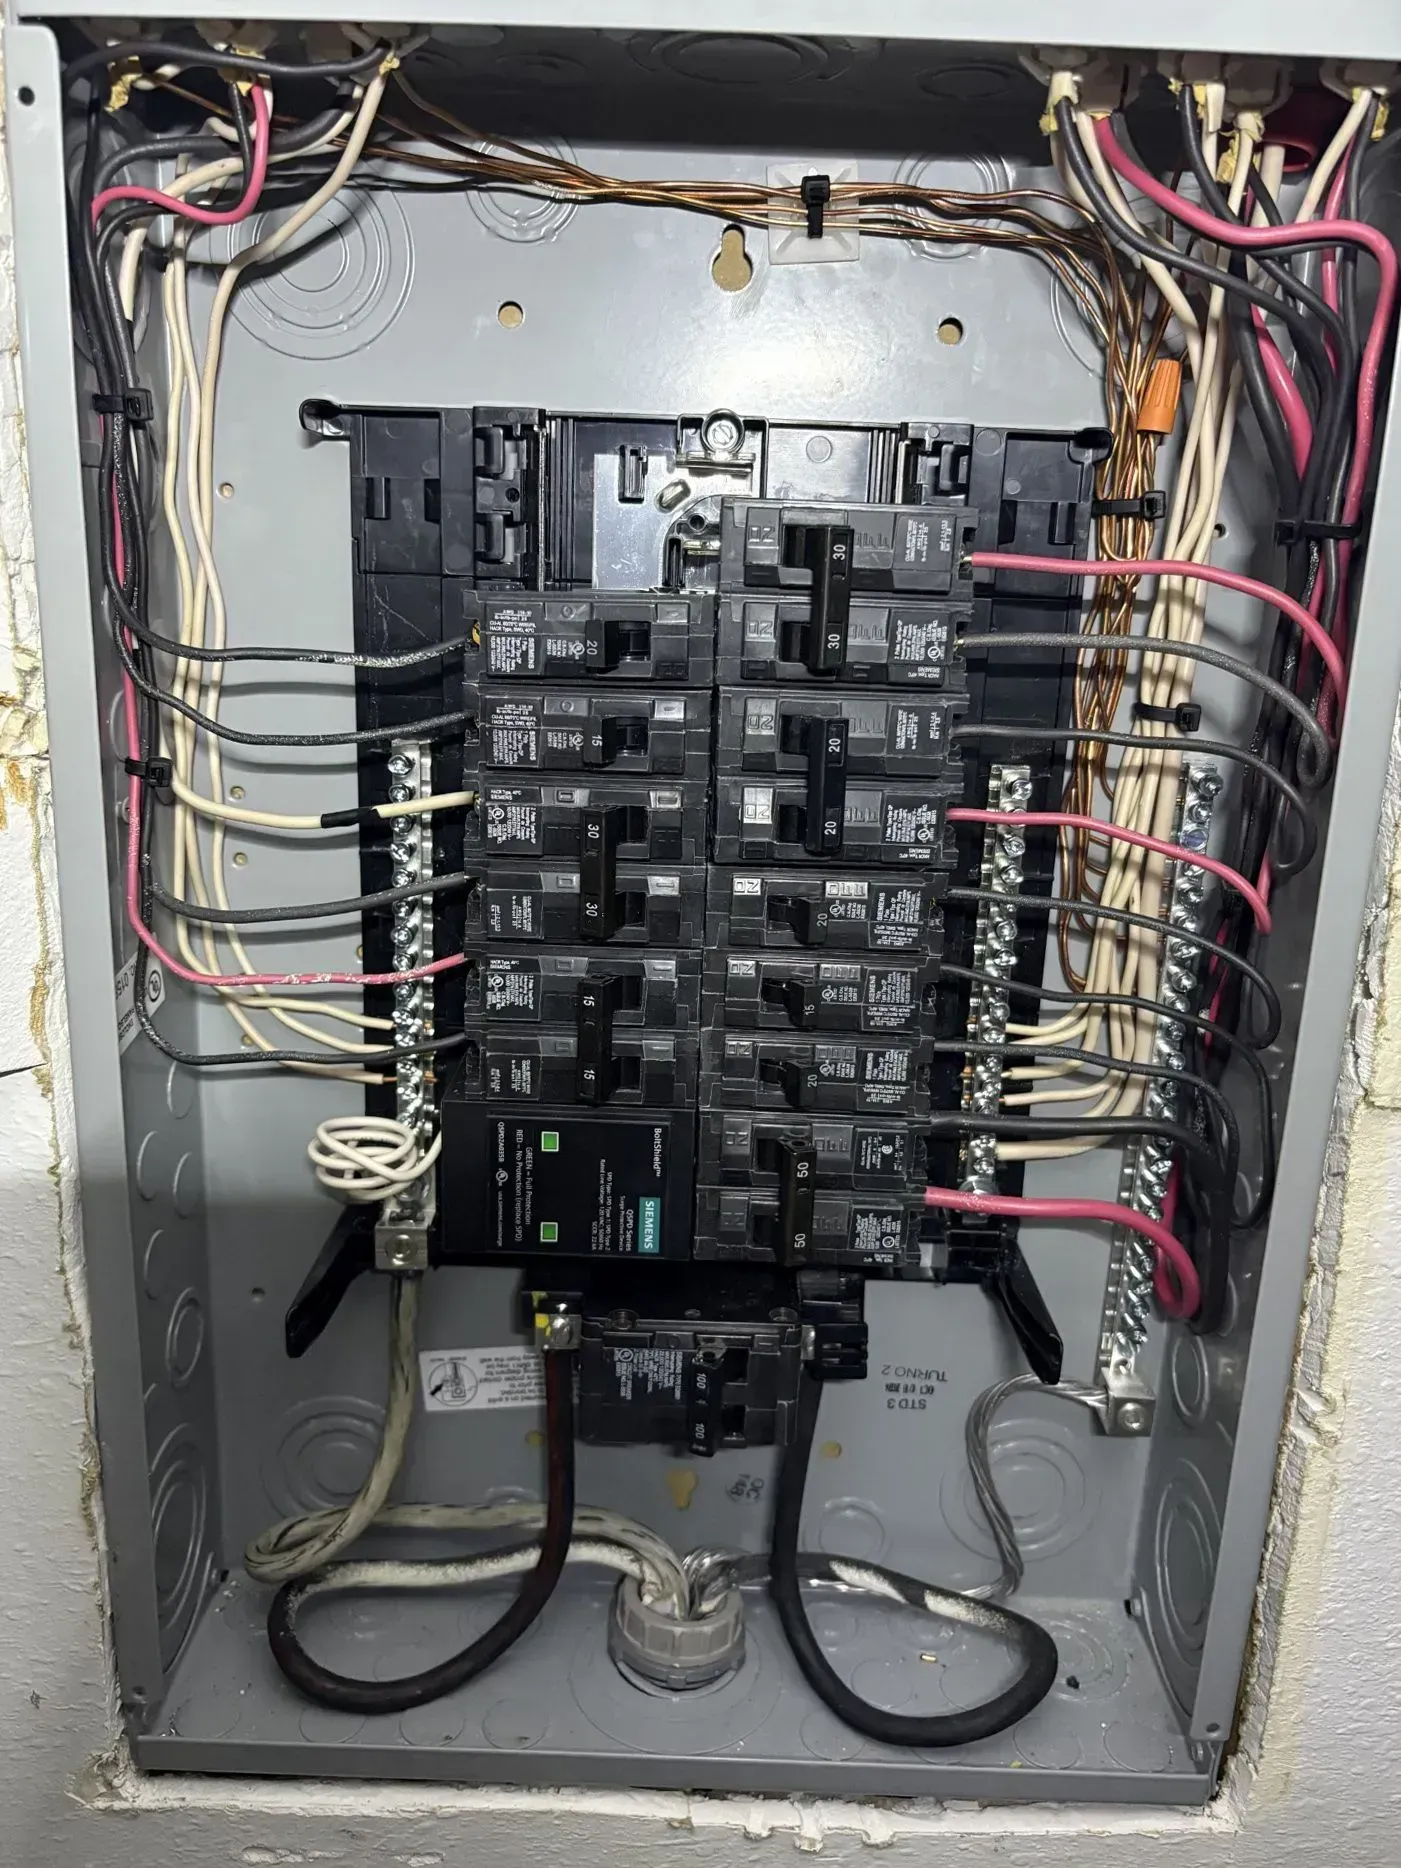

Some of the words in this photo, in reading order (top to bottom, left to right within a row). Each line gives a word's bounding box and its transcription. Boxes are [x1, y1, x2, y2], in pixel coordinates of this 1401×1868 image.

[833, 544, 846, 561] 30
[587, 640, 598, 656] 20
[828, 633, 840, 649] 30
[591, 735, 603, 747] 15
[828, 737, 841, 753] 20
[588, 824, 600, 839] 30
[824, 820, 836, 835] 20
[586, 902, 598, 917] 30
[877, 893, 885, 920] SIEMENS
[816, 913, 828, 927] 20
[583, 995, 594, 1007] 15
[804, 1003, 815, 1016] 15
[583, 1069, 595, 1081] 15
[807, 1074, 818, 1088] 20
[516, 1151, 522, 1160] No
[797, 1161, 809, 1179] 50
[644, 1201, 654, 1248] SIEMENS
[794, 1233, 806, 1248] 50
[881, 1365, 891, 1375] 2
[894, 1367, 948, 1382] TURNO
[697, 1372, 707, 1389] 100
[887, 1398, 896, 1409] 3
[898, 1398, 926, 1410] STD
[695, 1423, 705, 1440] 100
